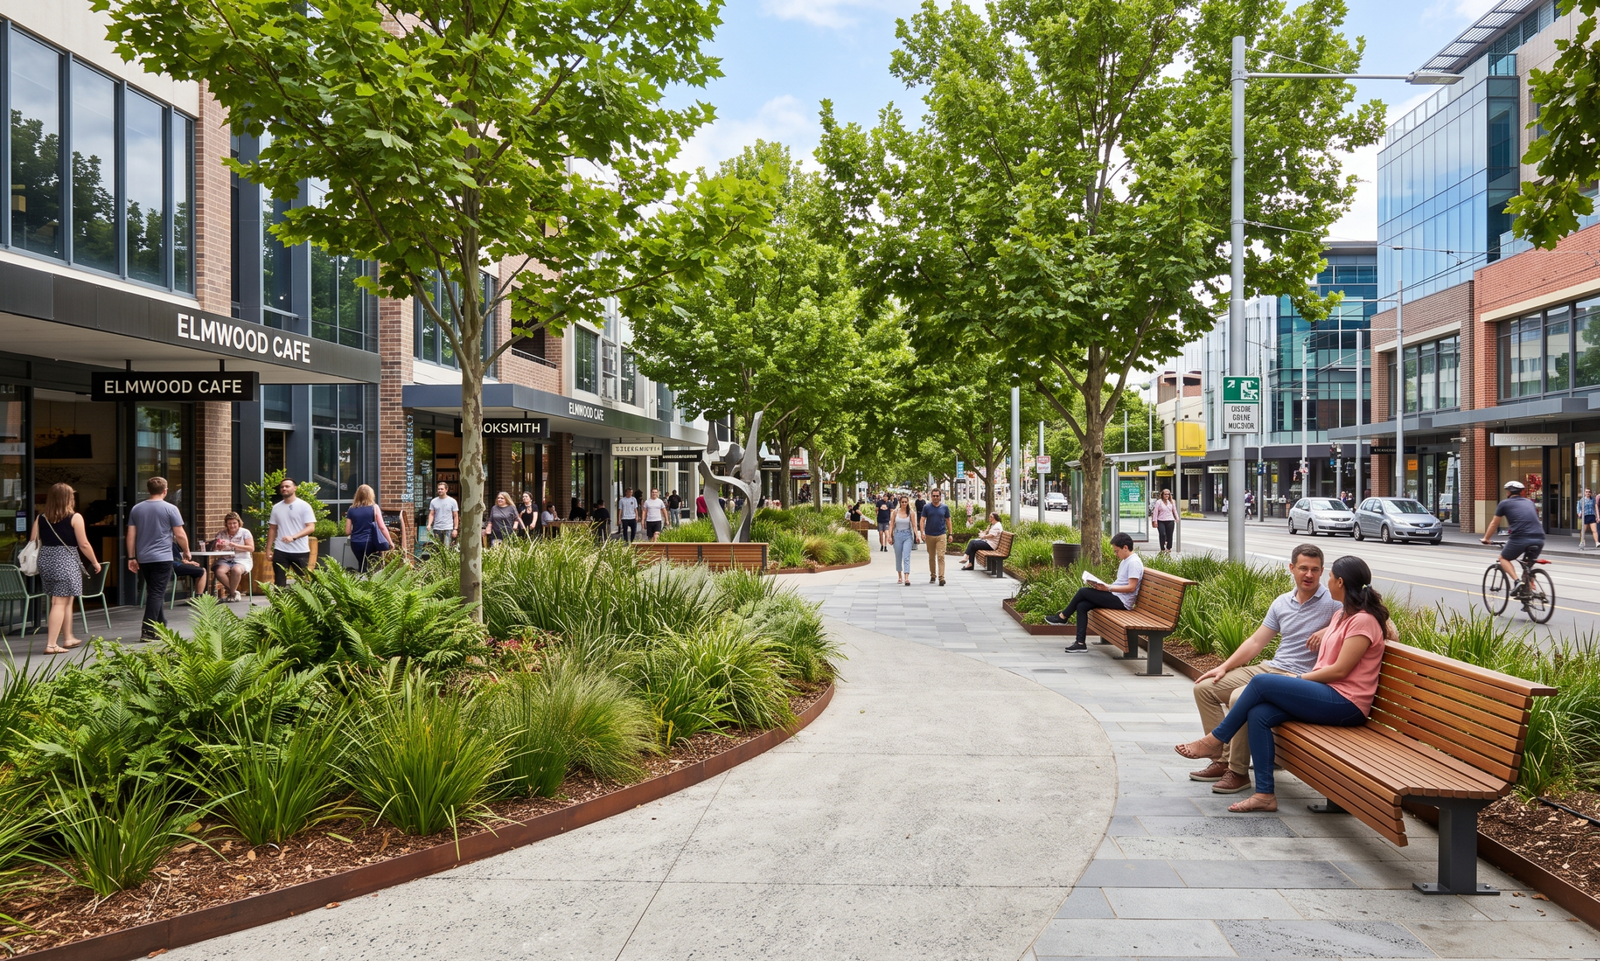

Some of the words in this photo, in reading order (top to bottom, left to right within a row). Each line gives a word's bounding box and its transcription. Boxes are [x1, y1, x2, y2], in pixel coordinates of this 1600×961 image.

[177, 313, 269, 354] ELMWOOD
[273, 336, 311, 363] CAFE
[104, 379, 193, 394] ELMWOOD
[197, 379, 242, 394] CAFE
[461, 422, 541, 434] OKSMITH
